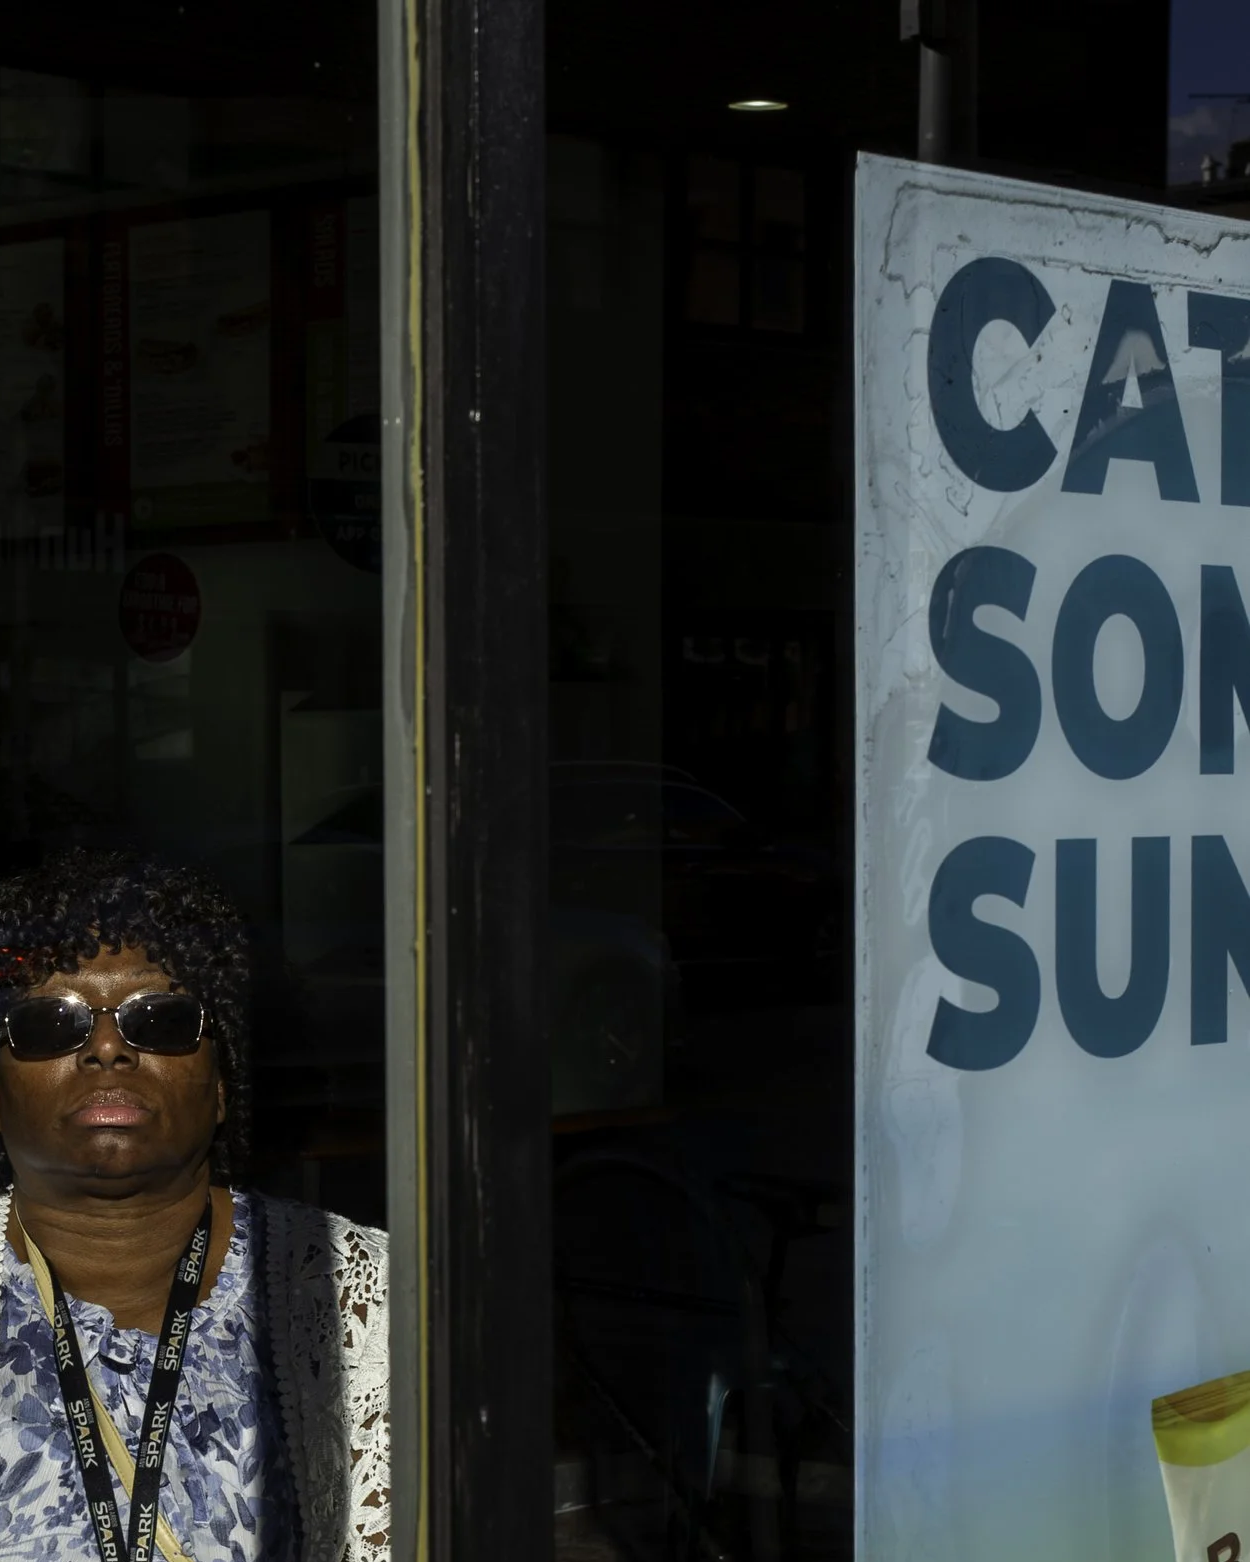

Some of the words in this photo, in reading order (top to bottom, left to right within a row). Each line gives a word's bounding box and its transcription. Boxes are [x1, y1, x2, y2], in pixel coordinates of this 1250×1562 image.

[338, 451, 380, 472] PIC
[184, 1228, 206, 1284] SPARK
[164, 1310, 188, 1371] SPARK
[70, 1399, 98, 1468] SPARK
[146, 1401, 169, 1467] SPARK
